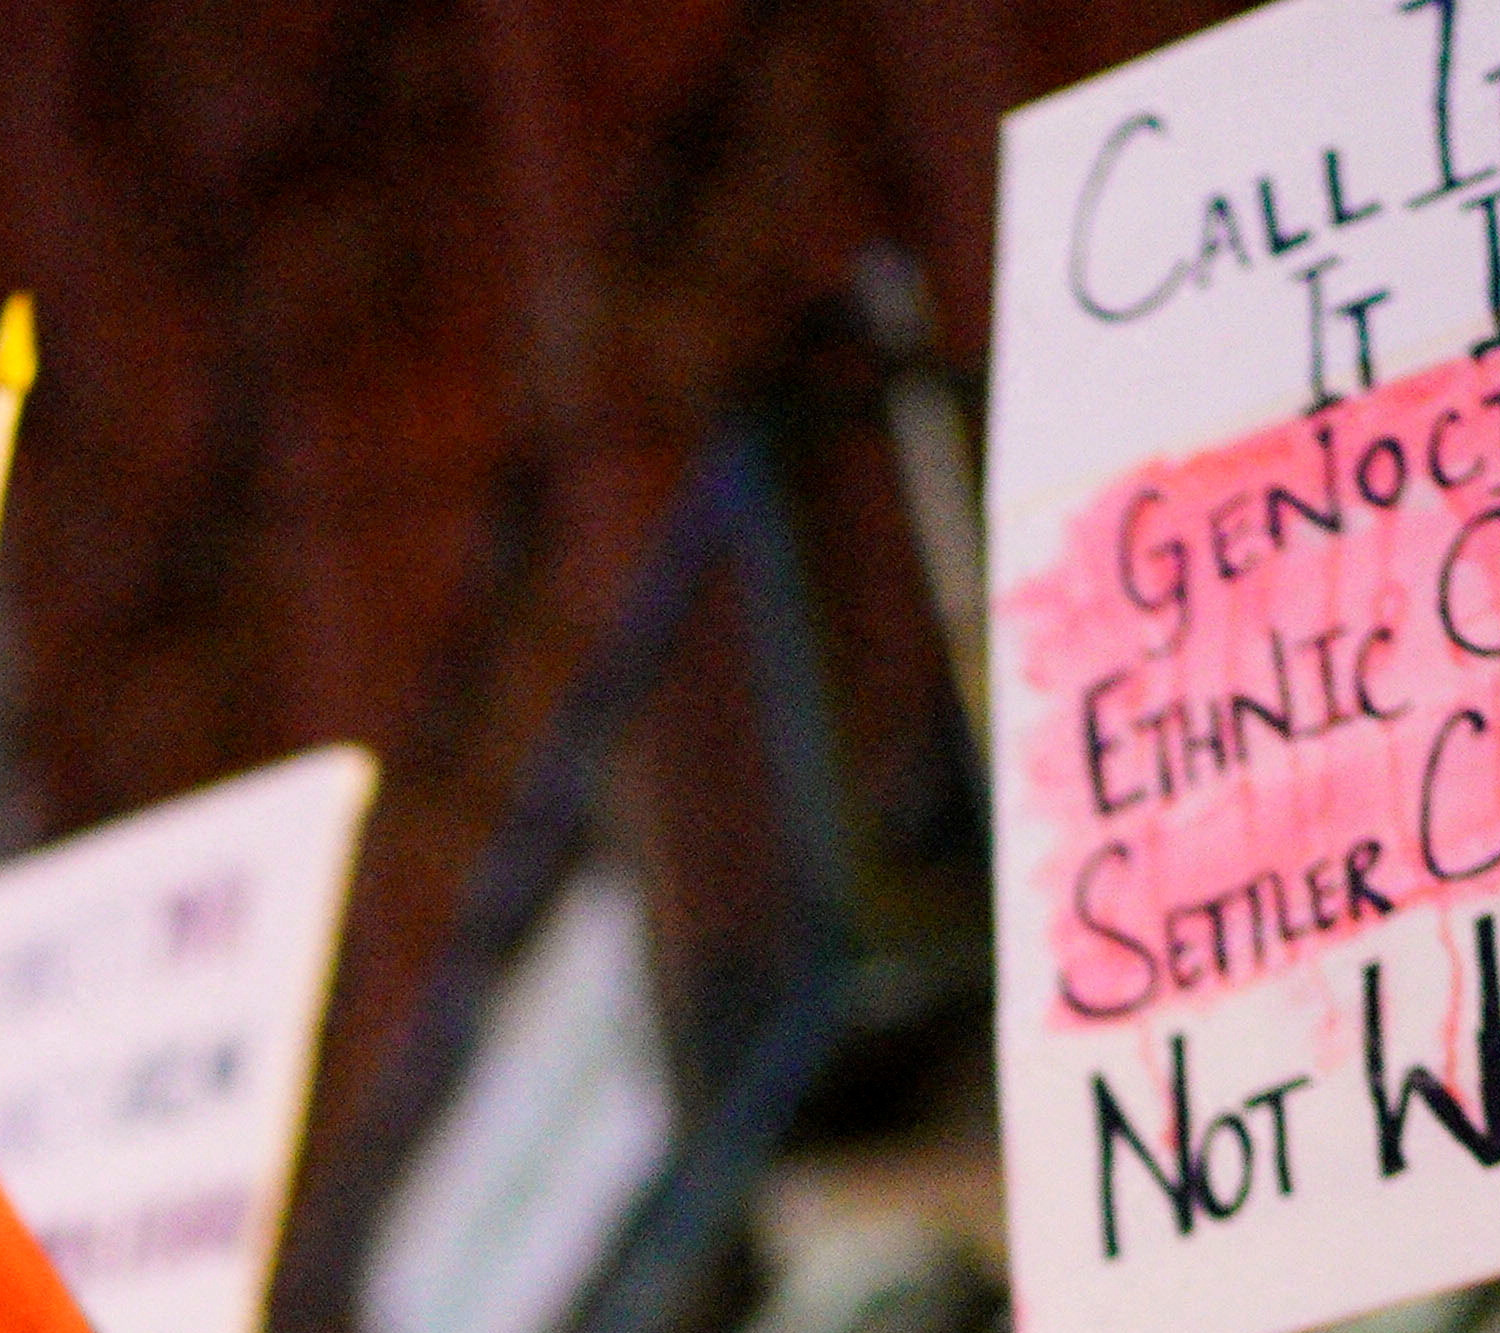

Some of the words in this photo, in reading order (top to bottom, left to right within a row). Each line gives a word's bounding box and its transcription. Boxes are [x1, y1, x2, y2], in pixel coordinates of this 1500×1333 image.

[1067, 110, 1382, 324] CALL
[1291, 254, 1391, 417] IT
[1081, 625, 1413, 817] ETHNIC
[1058, 838, 1395, 1021] SETTLER
[1090, 1034, 1312, 1261] NOT
